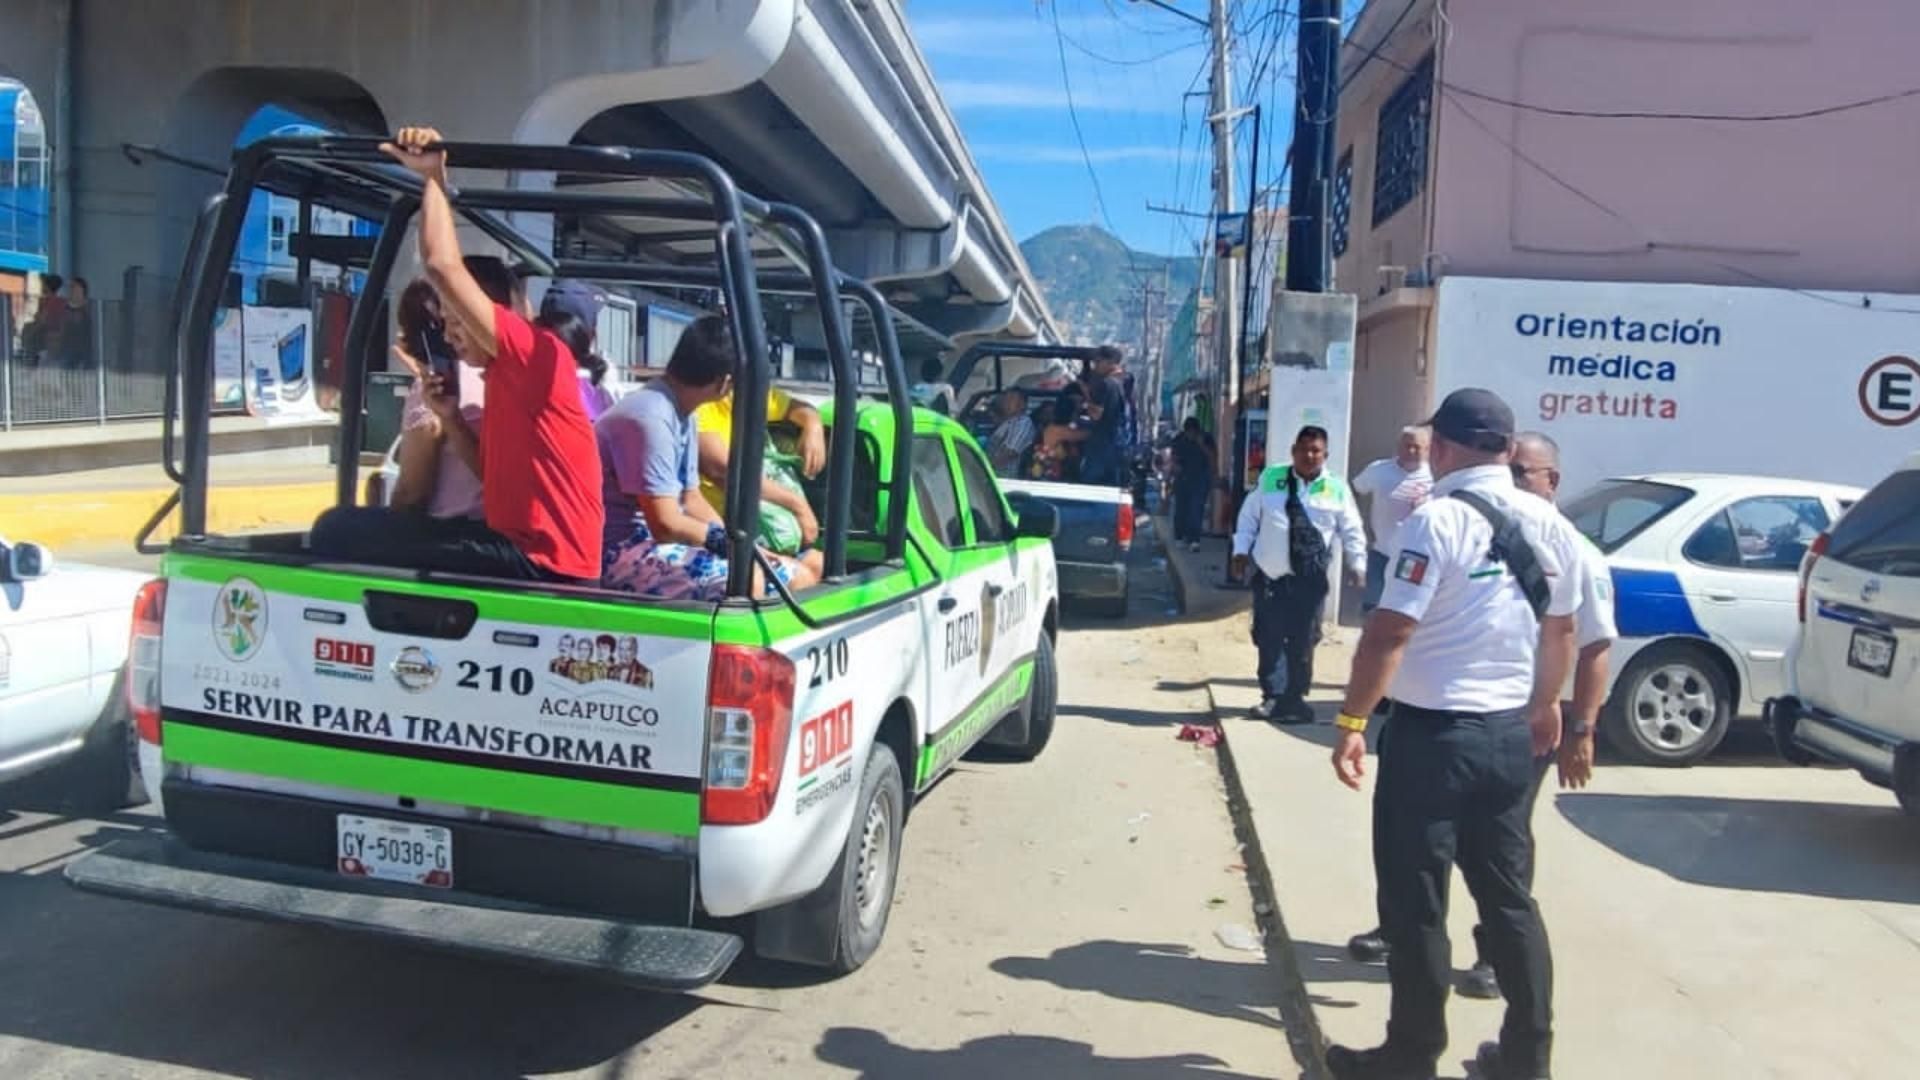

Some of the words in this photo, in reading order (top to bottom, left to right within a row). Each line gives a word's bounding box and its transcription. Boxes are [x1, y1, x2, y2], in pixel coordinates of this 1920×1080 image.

[1539, 391, 1678, 421] gratuita
[1879, 371, 1912, 411] E
[318, 640, 371, 665] 911
[807, 637, 849, 688] 210
[457, 660, 534, 696] 210
[203, 687, 303, 725] SERVIR
[312, 703, 392, 737] PARA
[402, 714, 651, 769] TRANSFORMAR
[539, 697, 660, 727] ACAPULCO
[801, 704, 850, 772] 911
[343, 832, 446, 869] GY-5038-G
